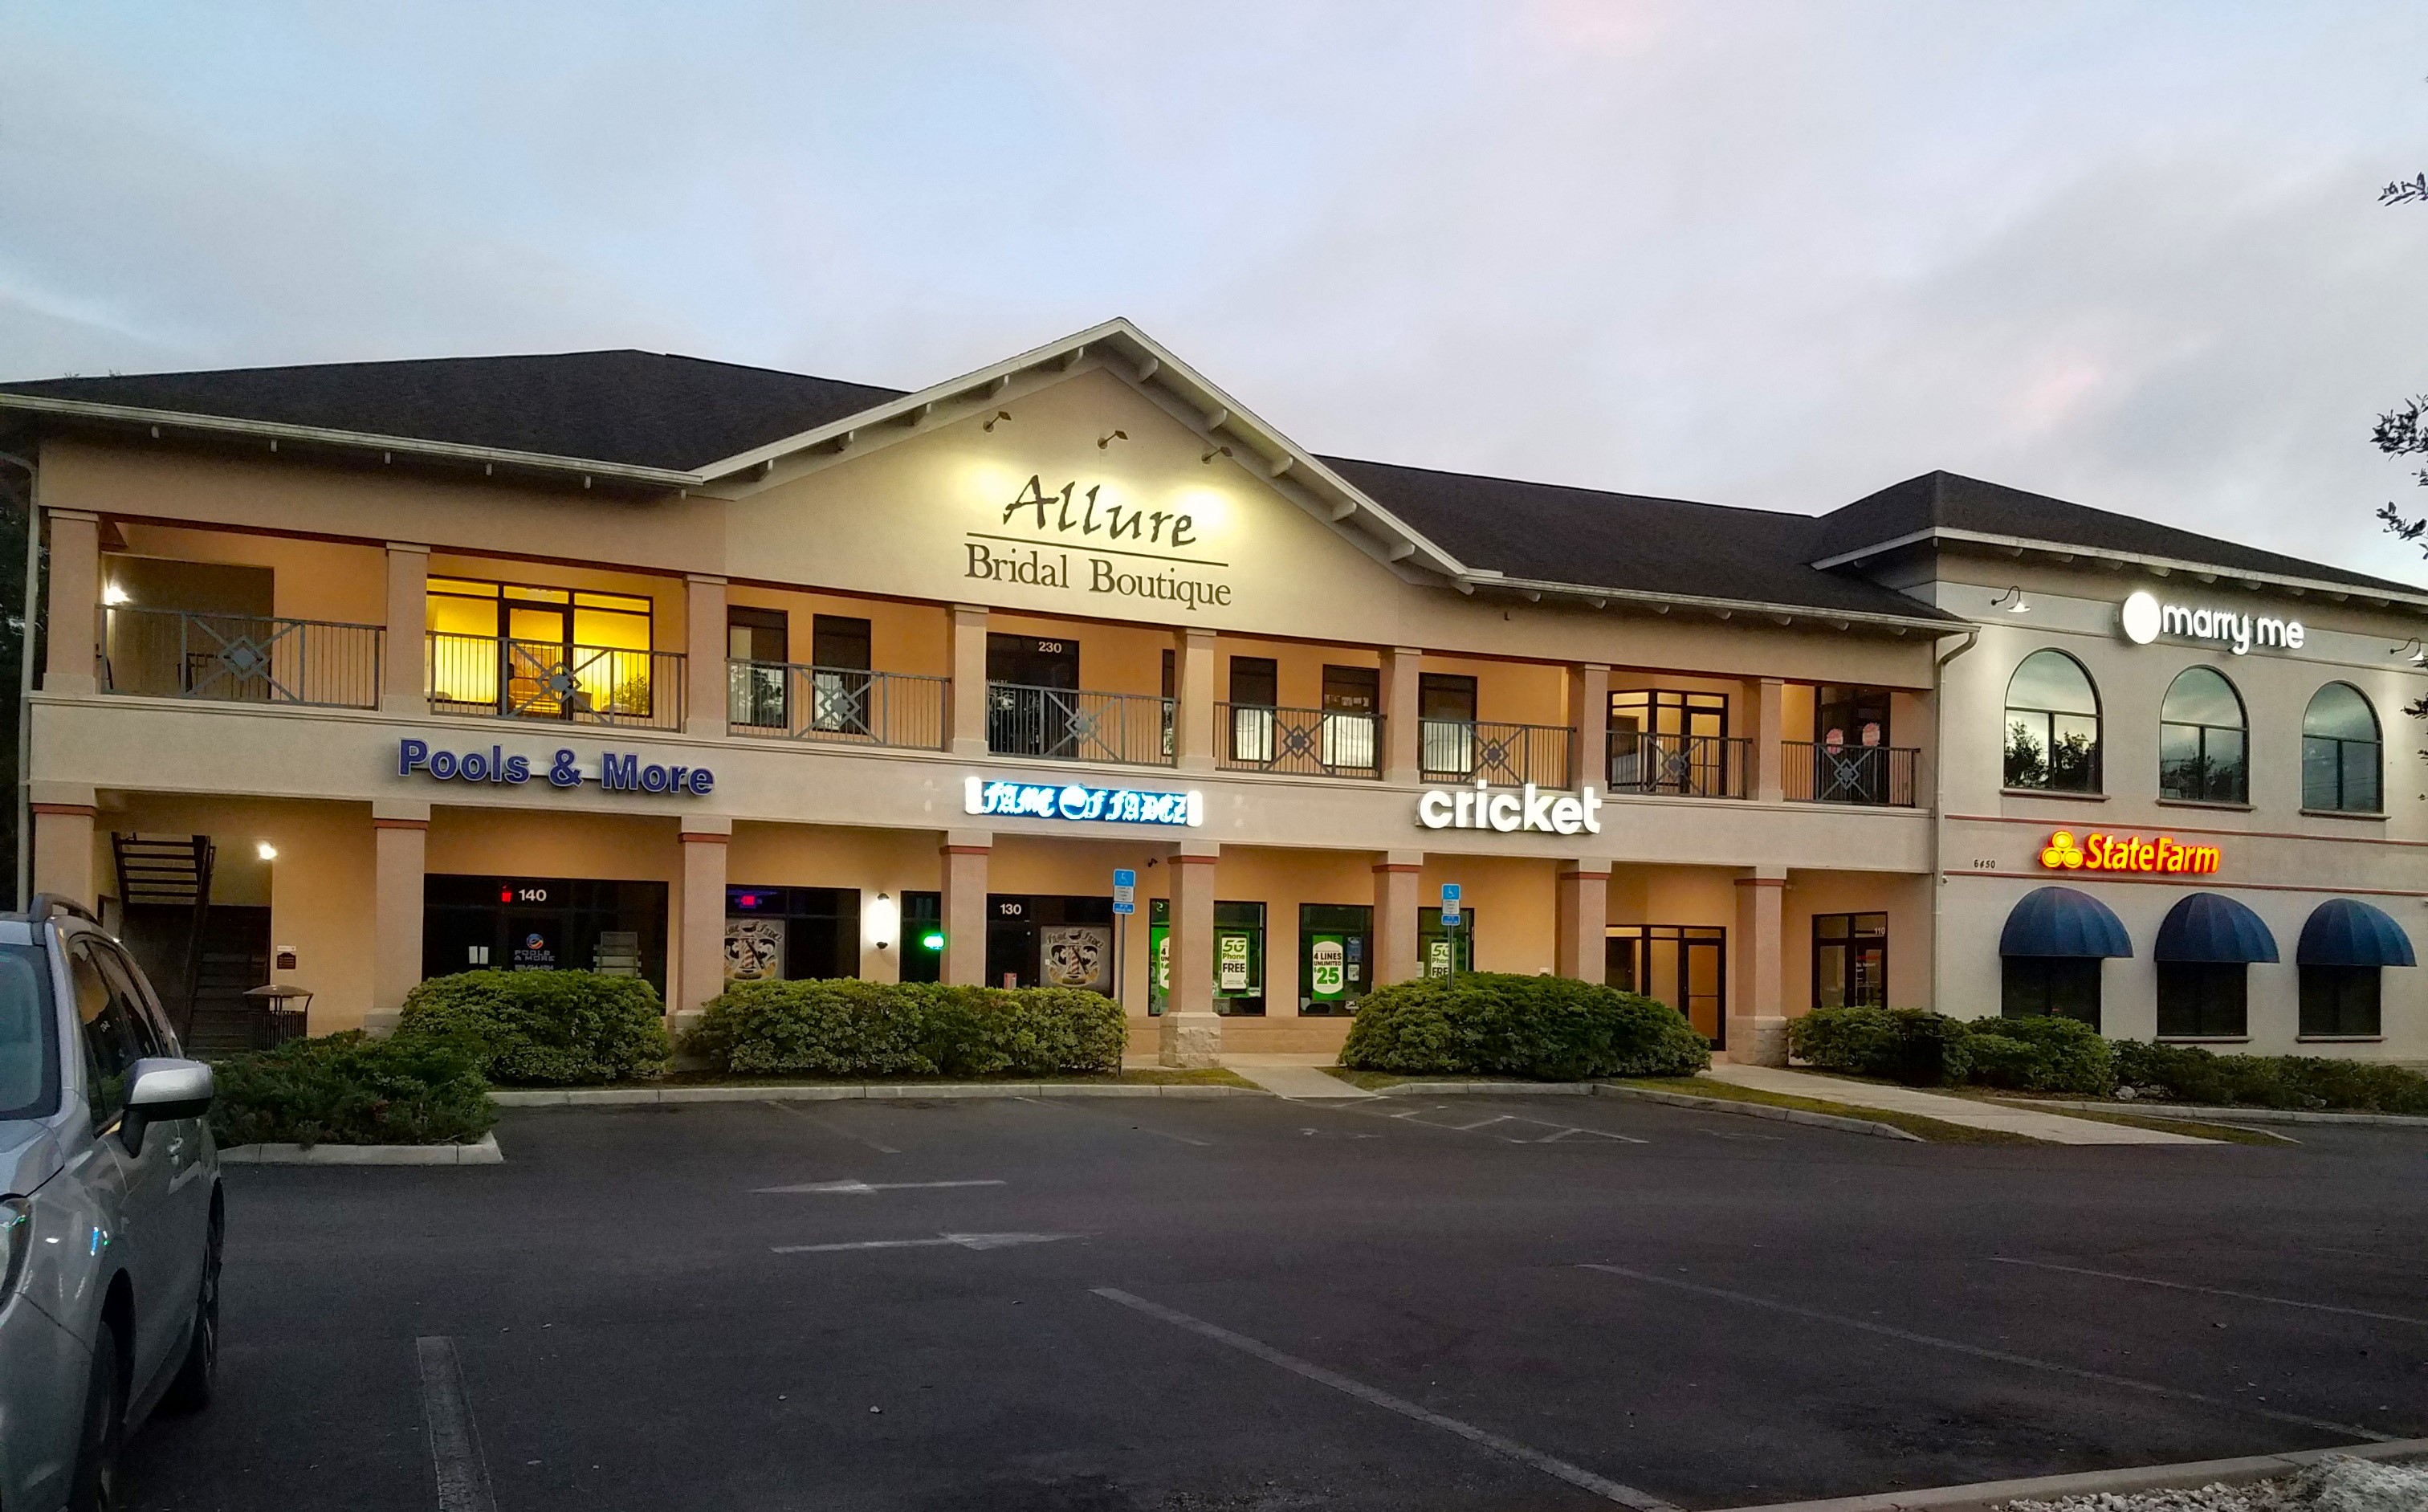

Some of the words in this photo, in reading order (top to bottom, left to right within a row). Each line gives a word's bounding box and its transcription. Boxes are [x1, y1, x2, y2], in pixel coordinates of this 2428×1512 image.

[1003, 475, 1196, 547] Allure
[963, 543, 1069, 589] Bridal
[1088, 558, 1232, 610] Boutique
[2162, 604, 2250, 655] marry
[2257, 616, 2305, 649] me
[1038, 641, 1062, 654] 230
[398, 737, 531, 785] Pools
[548, 748, 584, 788] &
[601, 751, 716, 796] More
[1418, 779, 1602, 835] cricket
[1974, 858, 1996, 869] 6450
[518, 889, 547, 902] 140
[1000, 903, 1022, 915] 130
[1874, 927, 1885, 935] 110
[1223, 939, 1245, 952] 5G
[1314, 952, 1319, 960] 4
[1321, 952, 1342, 960] LINES
[1222, 963, 1245, 973] FREE
[1432, 967, 1448, 976] FRE
